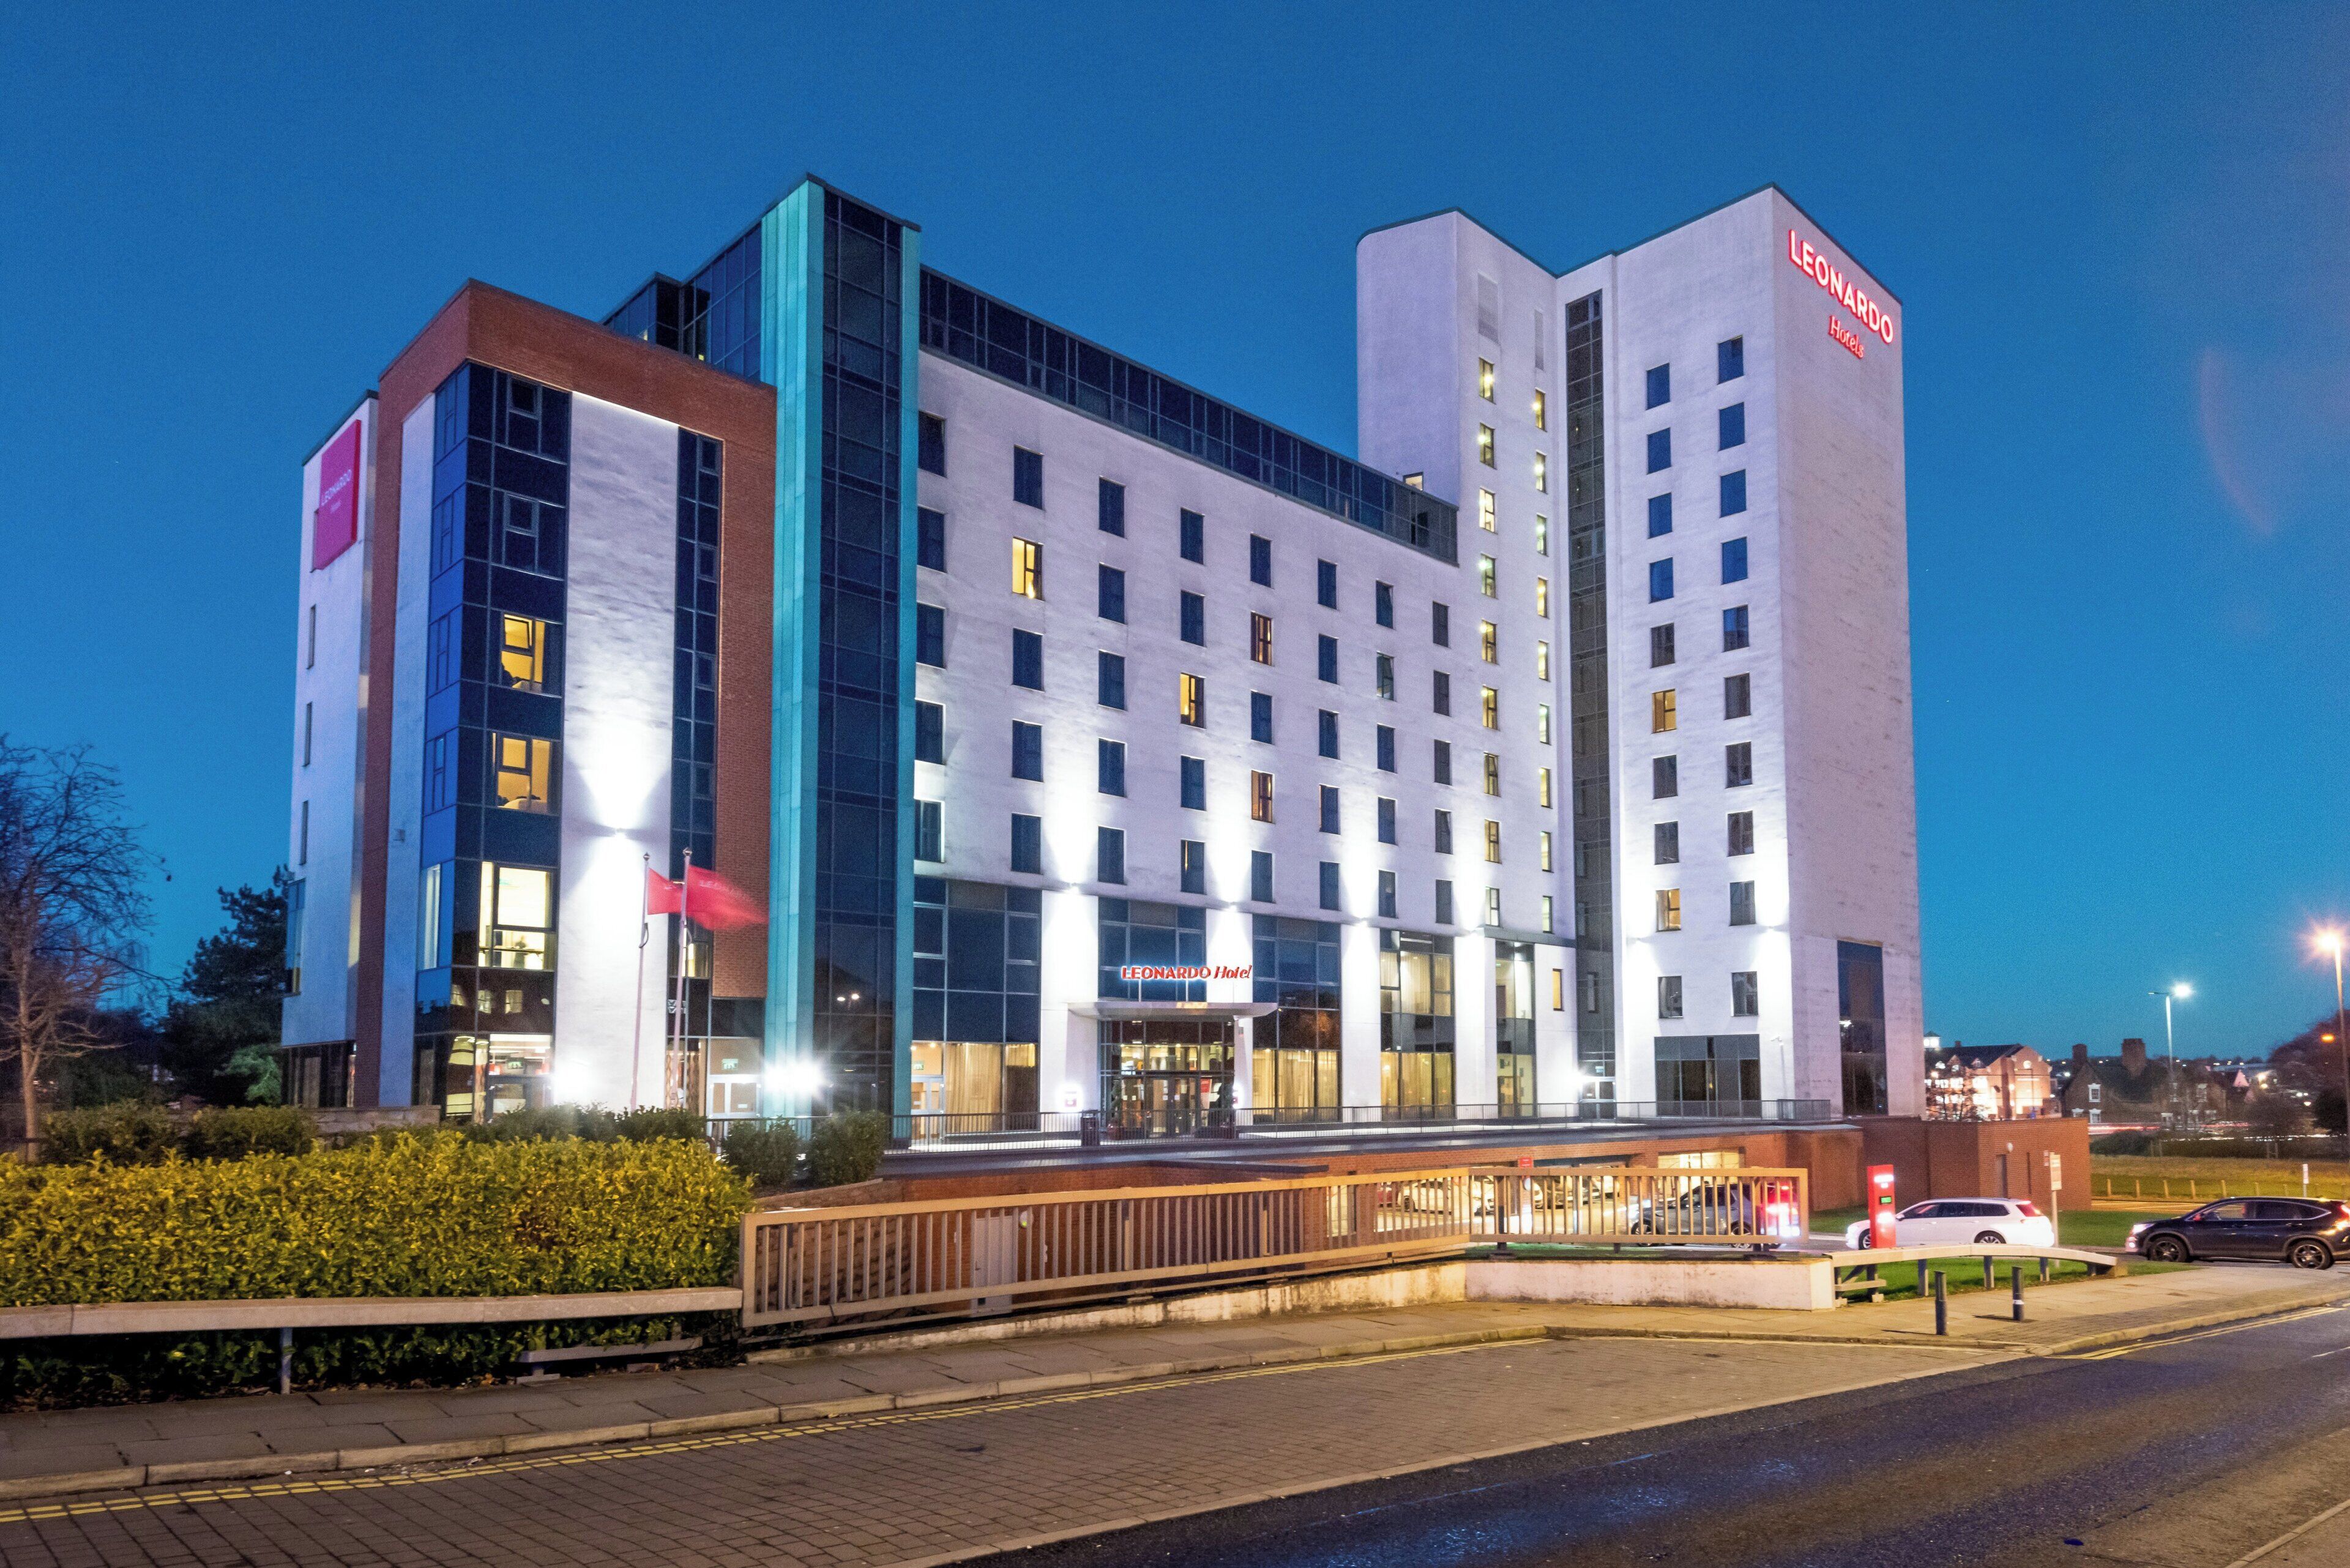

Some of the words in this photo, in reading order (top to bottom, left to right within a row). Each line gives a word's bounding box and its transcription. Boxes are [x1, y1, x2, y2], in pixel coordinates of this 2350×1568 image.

[1789, 229, 1894, 343] LEONARDO
[1829, 315, 1864, 359] Hotels
[1122, 966, 1211, 979] LEONARDO
[1214, 965, 1252, 979] Hotel
